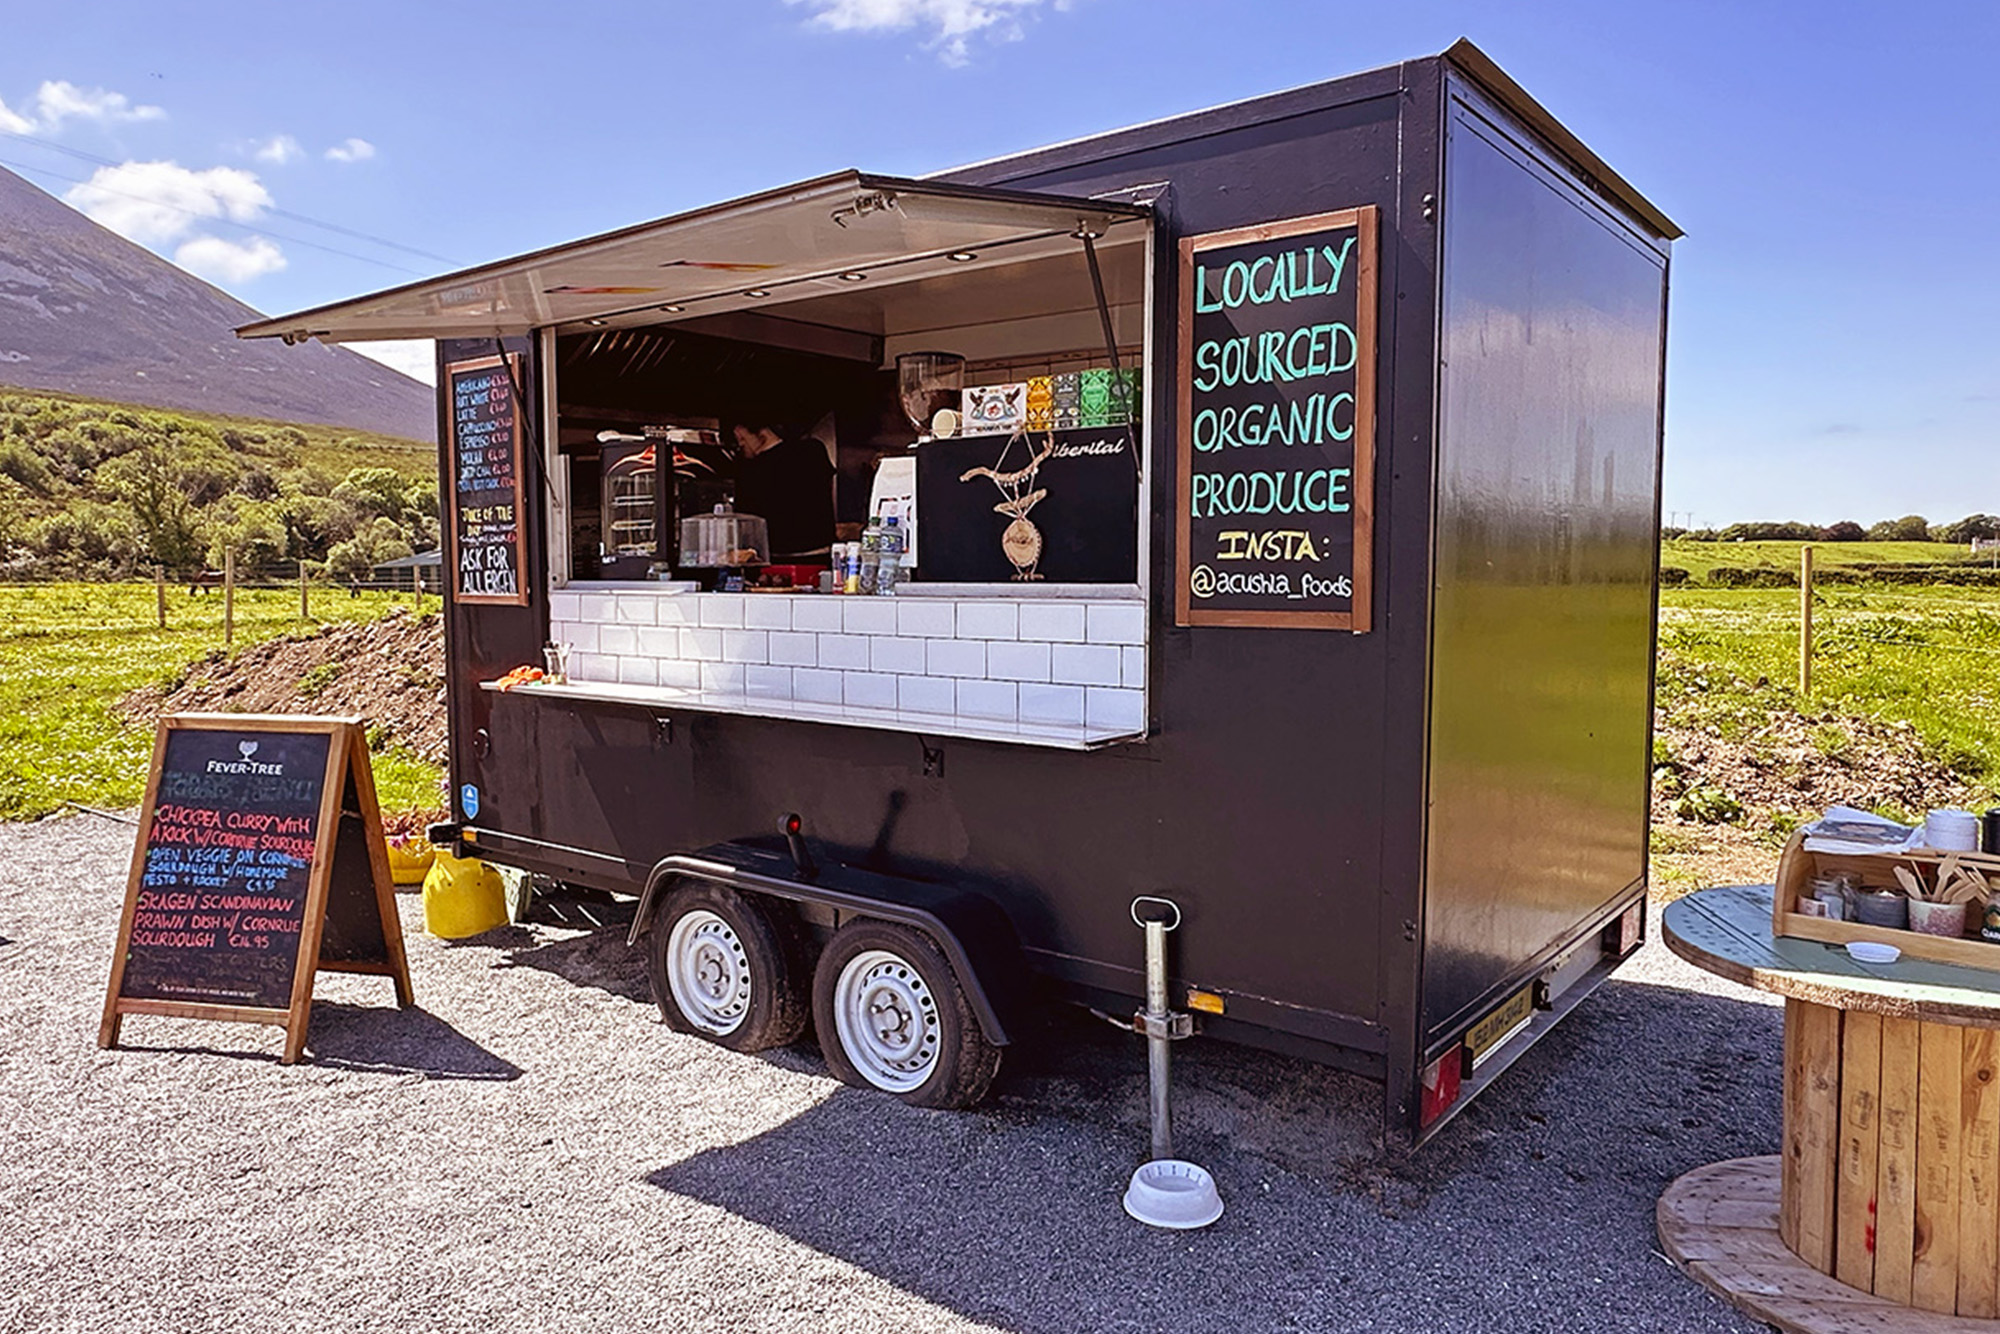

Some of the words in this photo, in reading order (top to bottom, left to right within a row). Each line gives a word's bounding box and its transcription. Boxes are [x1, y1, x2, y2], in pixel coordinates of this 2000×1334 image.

[1196, 236, 1357, 313] LOCALLY
[1194, 322, 1358, 392] SOURCED
[1192, 392, 1354, 453] ORGANIC
[1191, 468, 1351, 518] PRODUCE
[460, 547, 483, 572] ASK
[486, 545, 509, 570] FOR
[1216, 531, 1331, 562] INSTA:
[1190, 564, 1353, 598] @acushla_foods
[158, 804, 222, 828] CHICKPEA
[227, 812, 274, 832] CURRY
[274, 816, 310, 834] WITH
[150, 824, 160, 842] A
[160, 825, 192, 845] KICK
[149, 861, 216, 875] SOURDOUGH
[151, 848, 181, 862] OPEN
[187, 848, 233, 863] VEGGIE
[237, 850, 254, 863] ON
[143, 873, 177, 888] PESTO
[193, 875, 229, 888] ROCKET
[138, 891, 198, 911] SKAGEN
[200, 895, 295, 912] SCANDINAVIAN
[134, 912, 187, 929] PRAWN
[191, 915, 221, 930] DISH
[132, 930, 216, 947] SOURDOUGH
